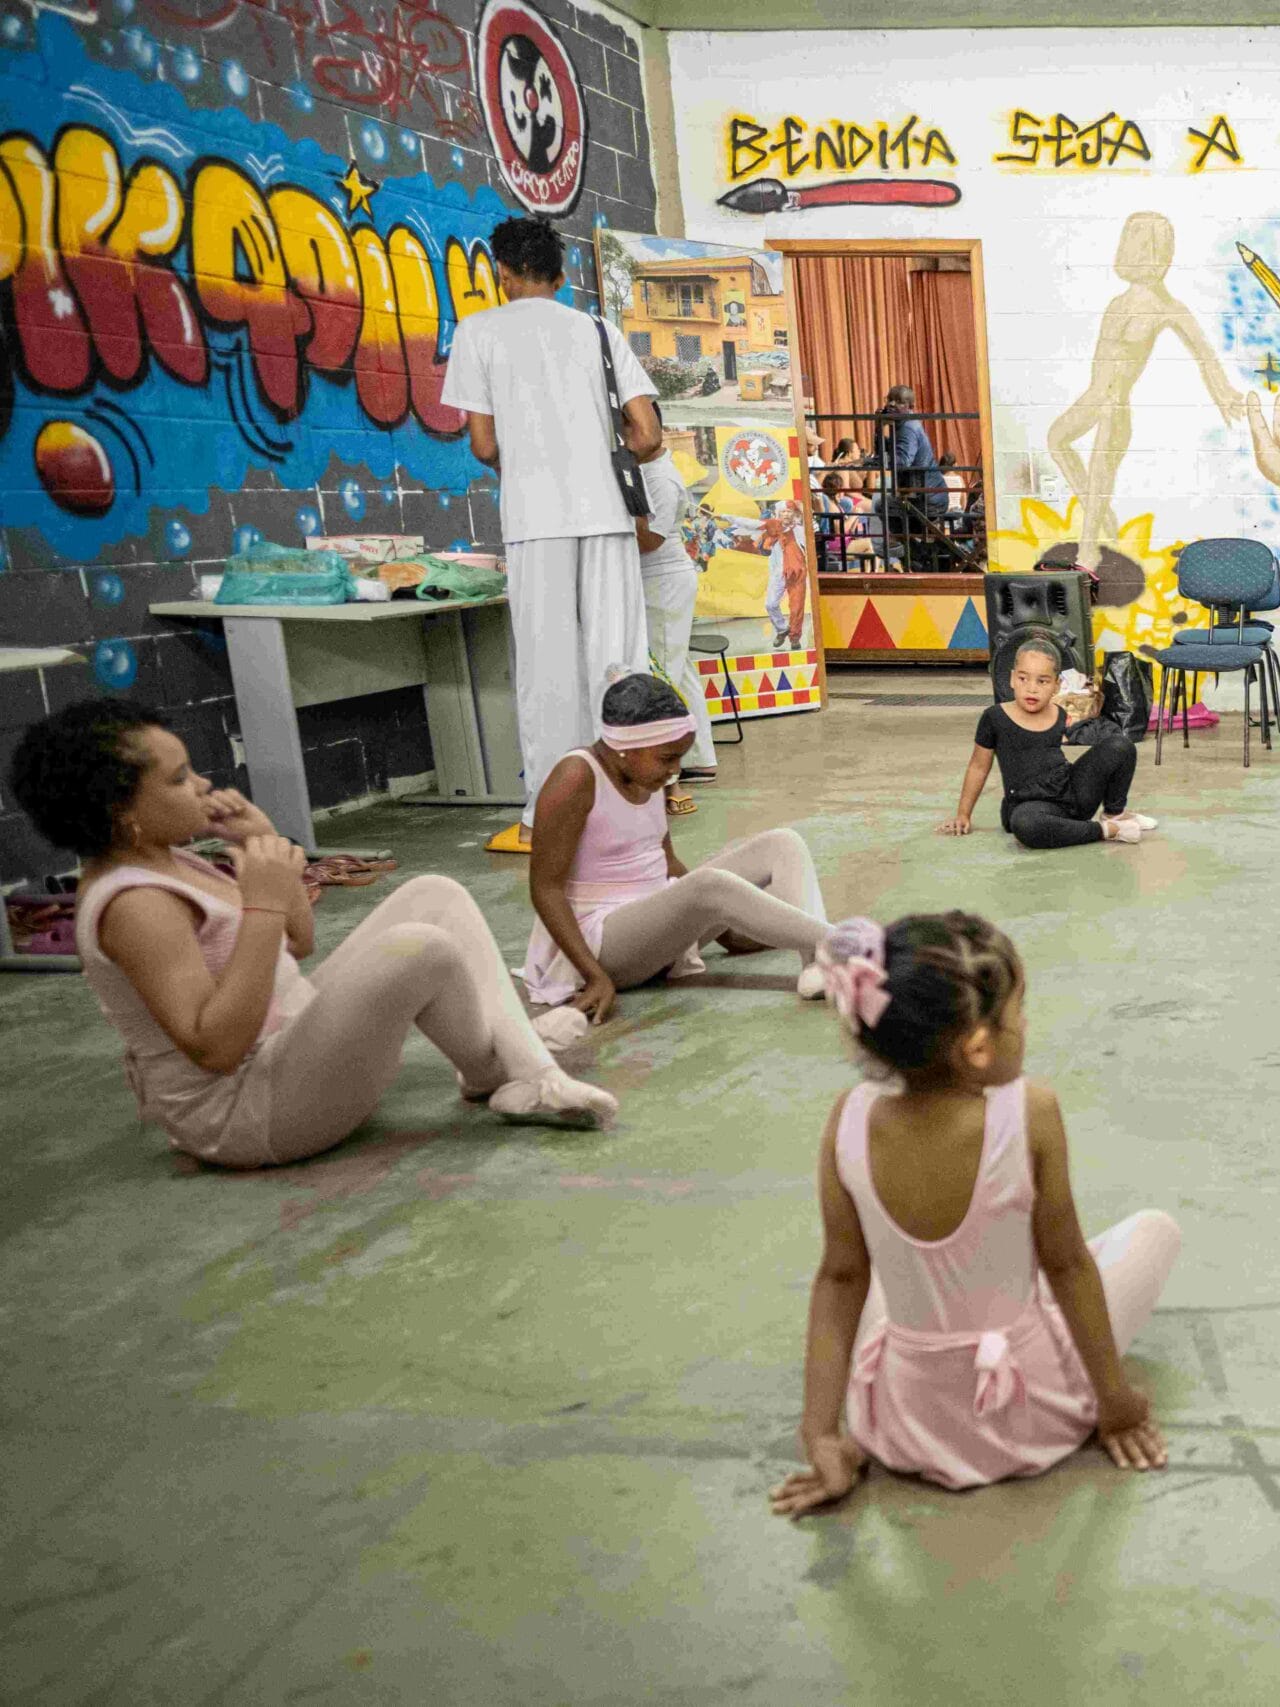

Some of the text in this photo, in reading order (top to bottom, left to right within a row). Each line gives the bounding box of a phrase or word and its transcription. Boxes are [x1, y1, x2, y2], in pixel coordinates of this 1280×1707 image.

[731, 115, 955, 178] BENDITA
[997, 112, 1151, 167] SEJA
[1188, 116, 1240, 168] A
[511, 160, 550, 201] CIRCO
